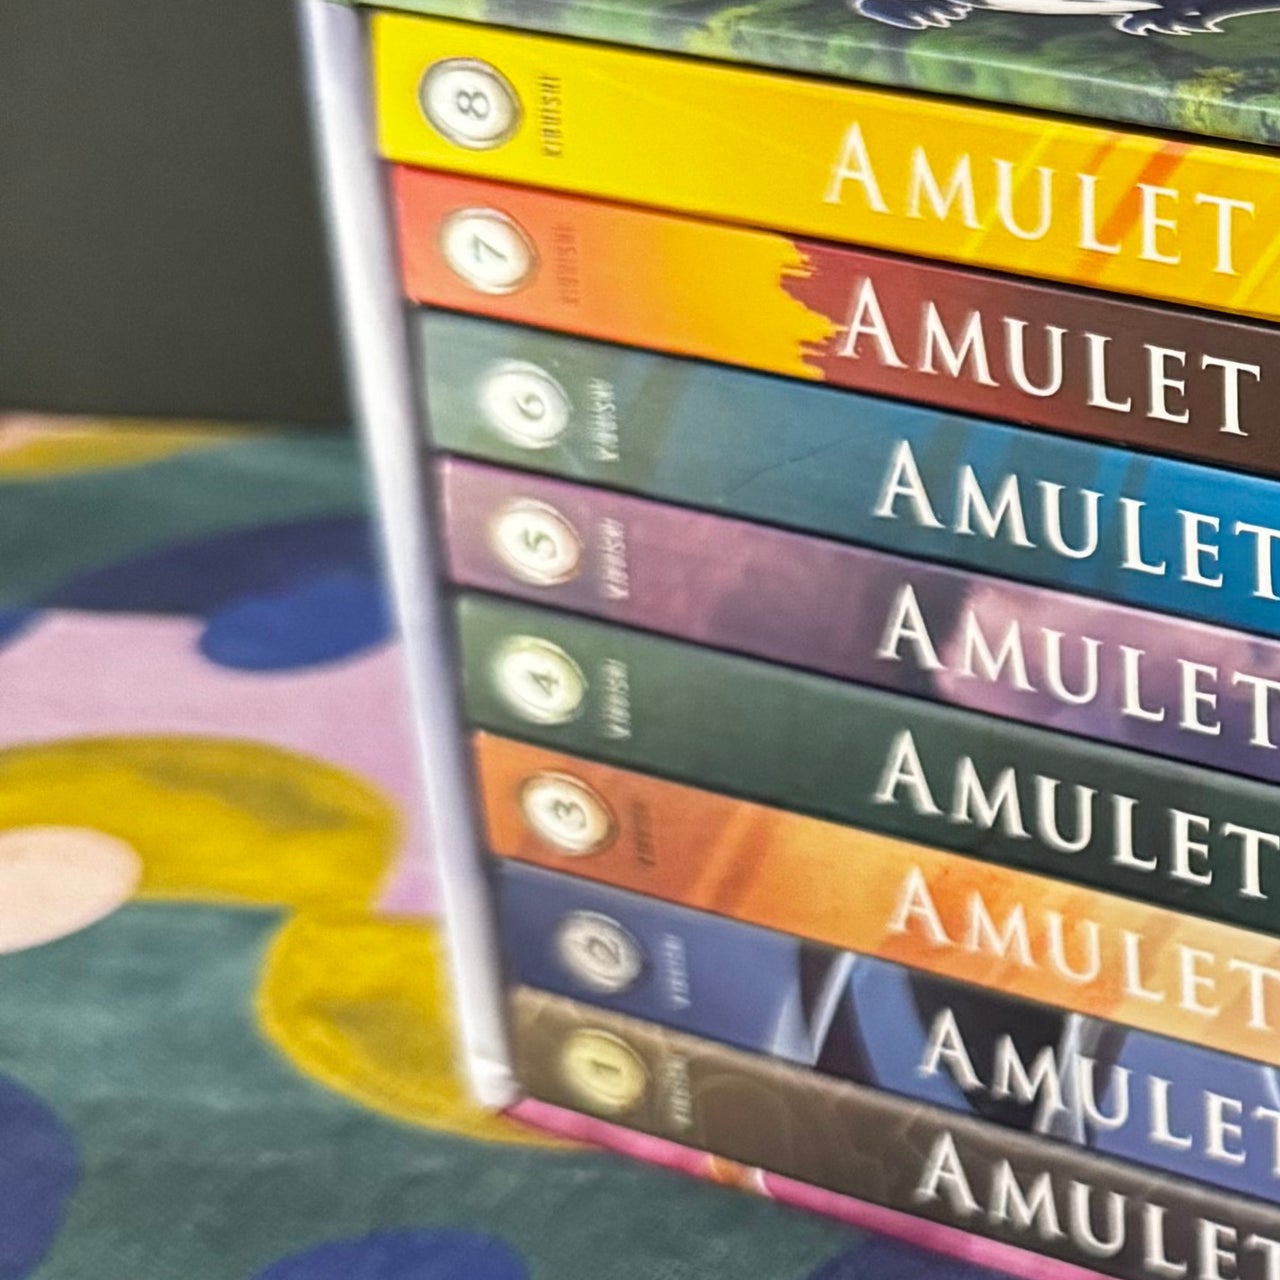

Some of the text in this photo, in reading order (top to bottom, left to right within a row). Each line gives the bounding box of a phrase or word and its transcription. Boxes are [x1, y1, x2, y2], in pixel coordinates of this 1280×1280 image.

[824, 120, 1256, 277] AMULET
[838, 276, 1261, 438] AMULET
[874, 728, 1280, 900] AMULET
